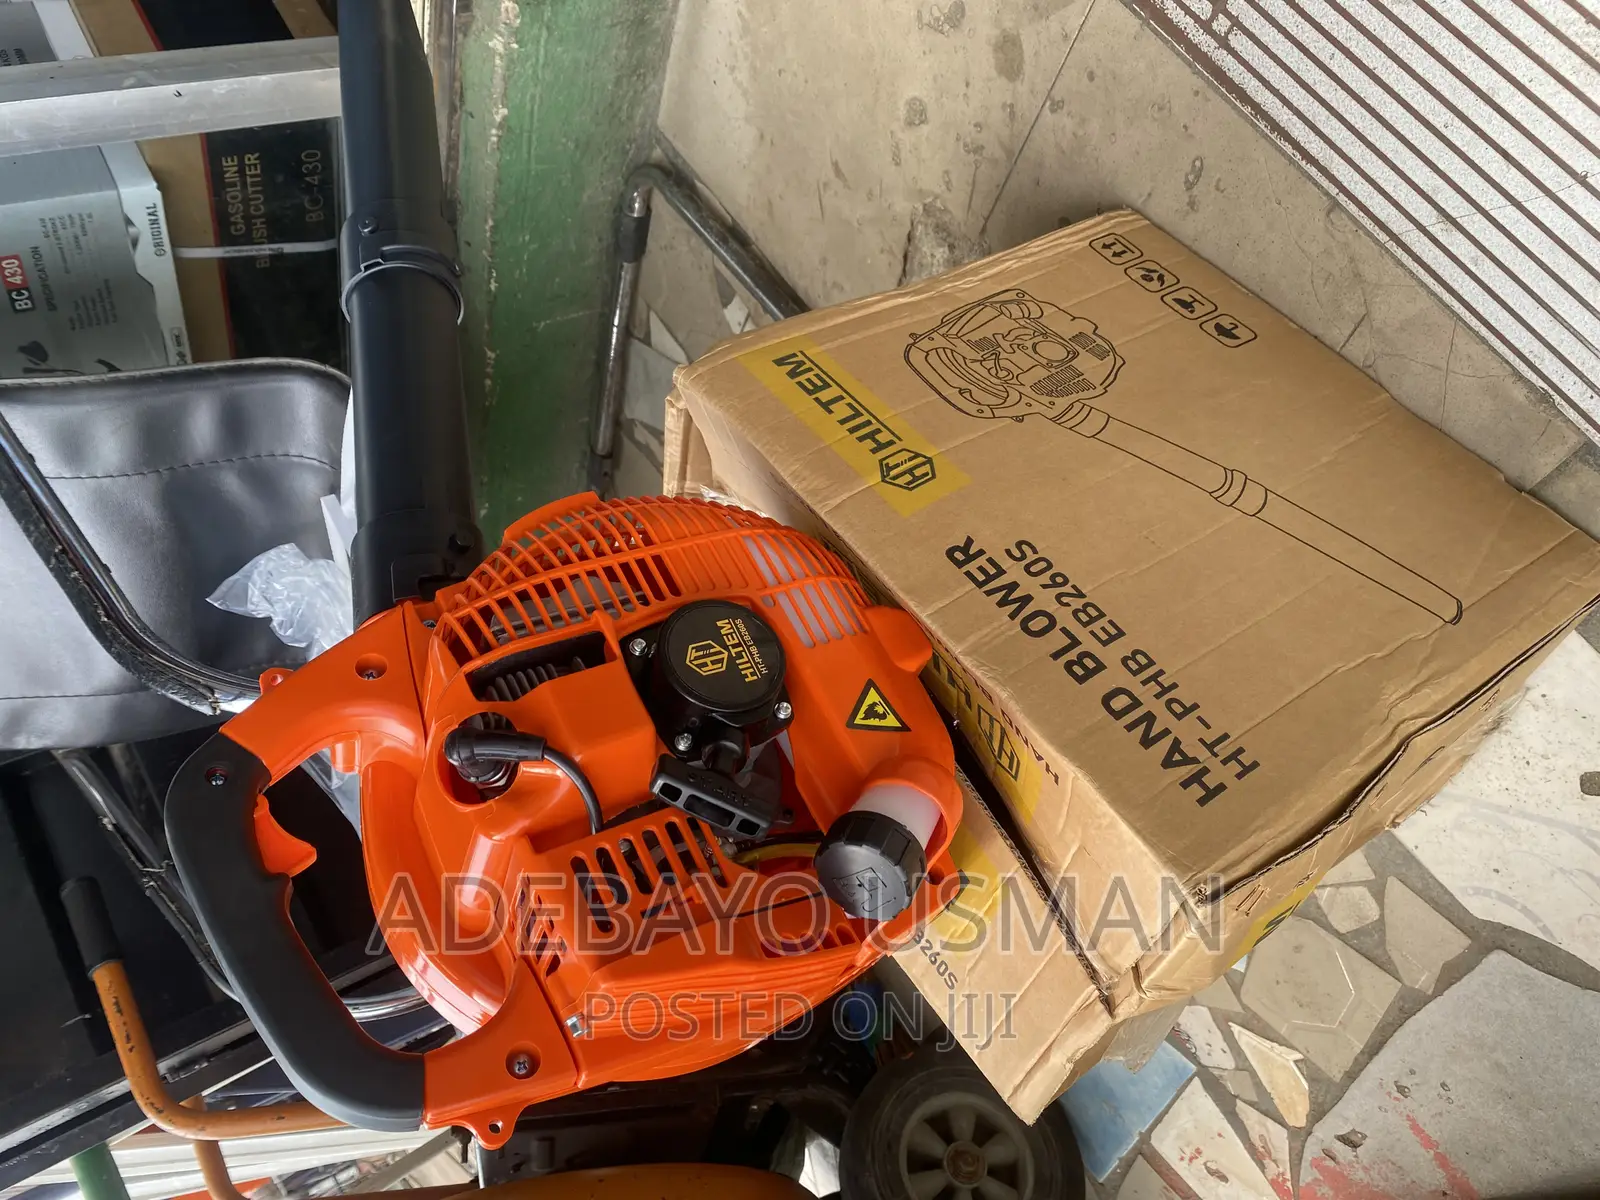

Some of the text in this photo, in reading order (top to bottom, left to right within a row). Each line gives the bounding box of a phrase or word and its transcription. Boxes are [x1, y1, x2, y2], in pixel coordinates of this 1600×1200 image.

[222, 155, 245, 235] GASOLINE
[244, 152, 265, 215] CUTTER
[301, 149, 324, 222] BC-430
[1, 258, 33, 311] BC 430
[29, 246, 58, 312] SPECIFICATION
[771, 352, 897, 455] HILTEM
[945, 535, 1108, 685] BLOWER
[1004, 539, 1127, 648] EB260S
[715, 618, 758, 683] HILTEM
[734, 618, 769, 675] HT-PHB EB260S
[1100, 686, 1228, 808] HAND
[1120, 648, 1261, 781] HT-PHB
